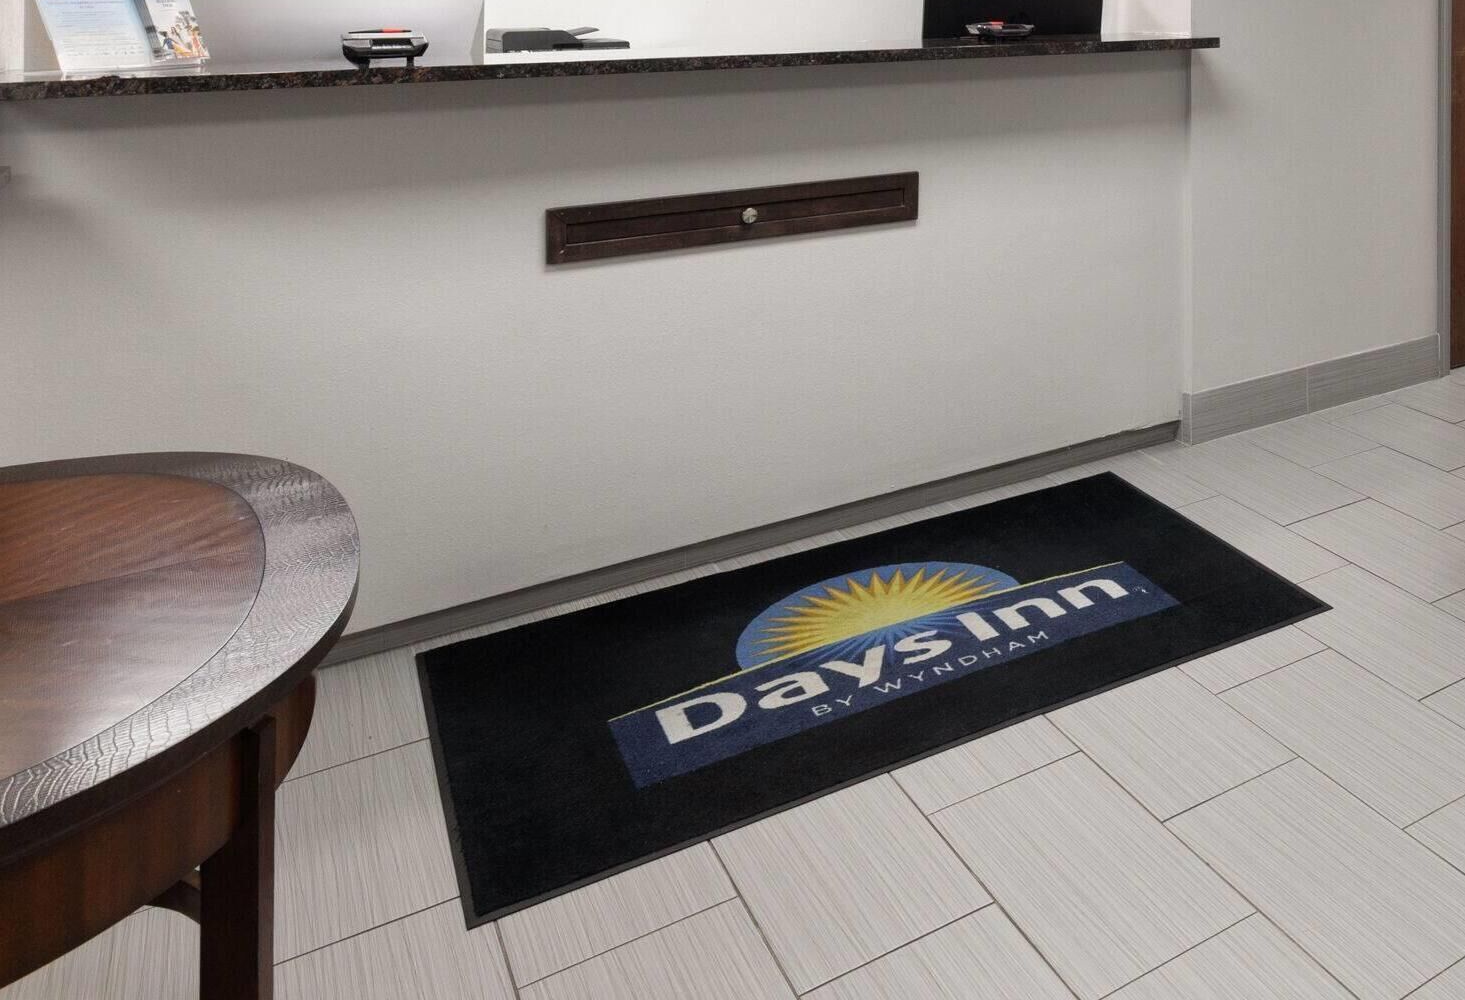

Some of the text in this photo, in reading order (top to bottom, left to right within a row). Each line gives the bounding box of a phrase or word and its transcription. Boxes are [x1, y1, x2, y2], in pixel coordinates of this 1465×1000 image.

[655, 579, 1130, 745] Days Inn
[811, 630, 1049, 717] BY WYNDHAM
